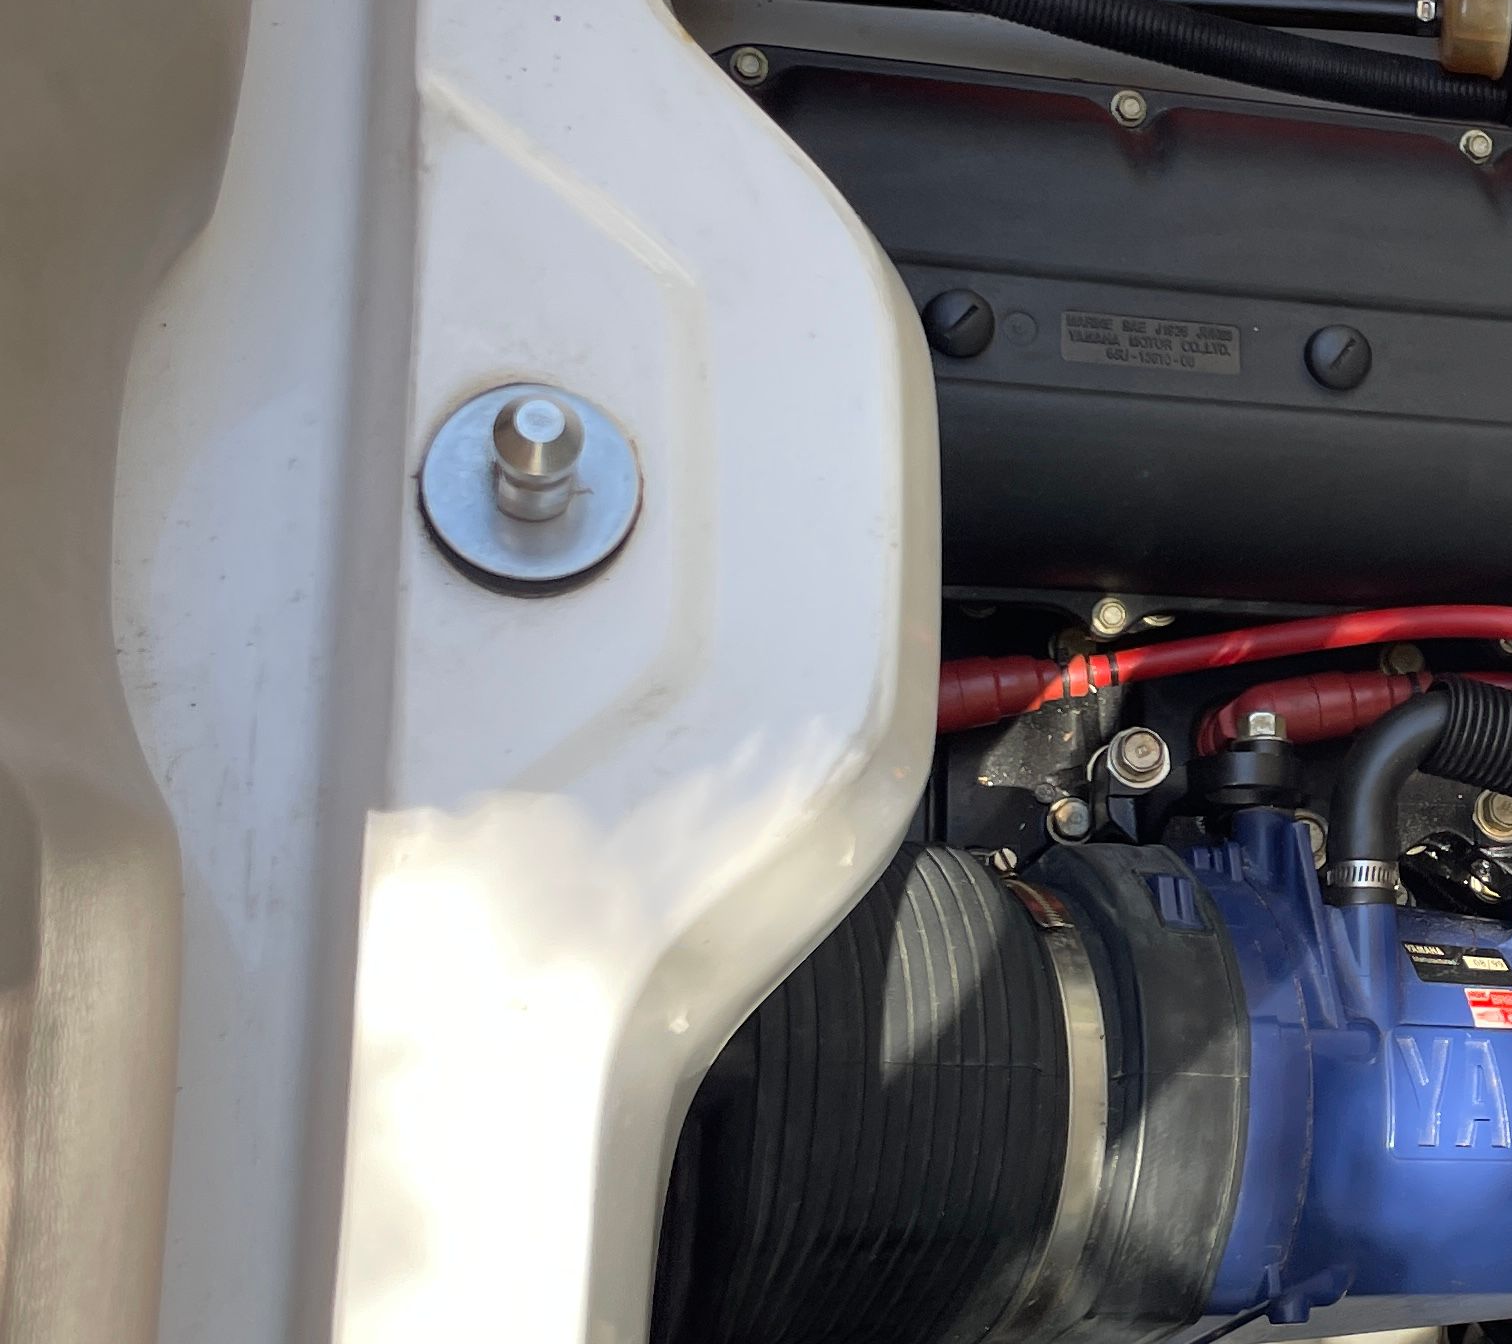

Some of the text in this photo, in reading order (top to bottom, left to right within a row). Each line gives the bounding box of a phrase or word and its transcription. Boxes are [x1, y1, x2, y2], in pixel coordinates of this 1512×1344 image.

[1068, 329, 1121, 346] YAMAHA
[1129, 335, 1172, 351] MOTOR
[1404, 943, 1445, 956] YAMAHA
